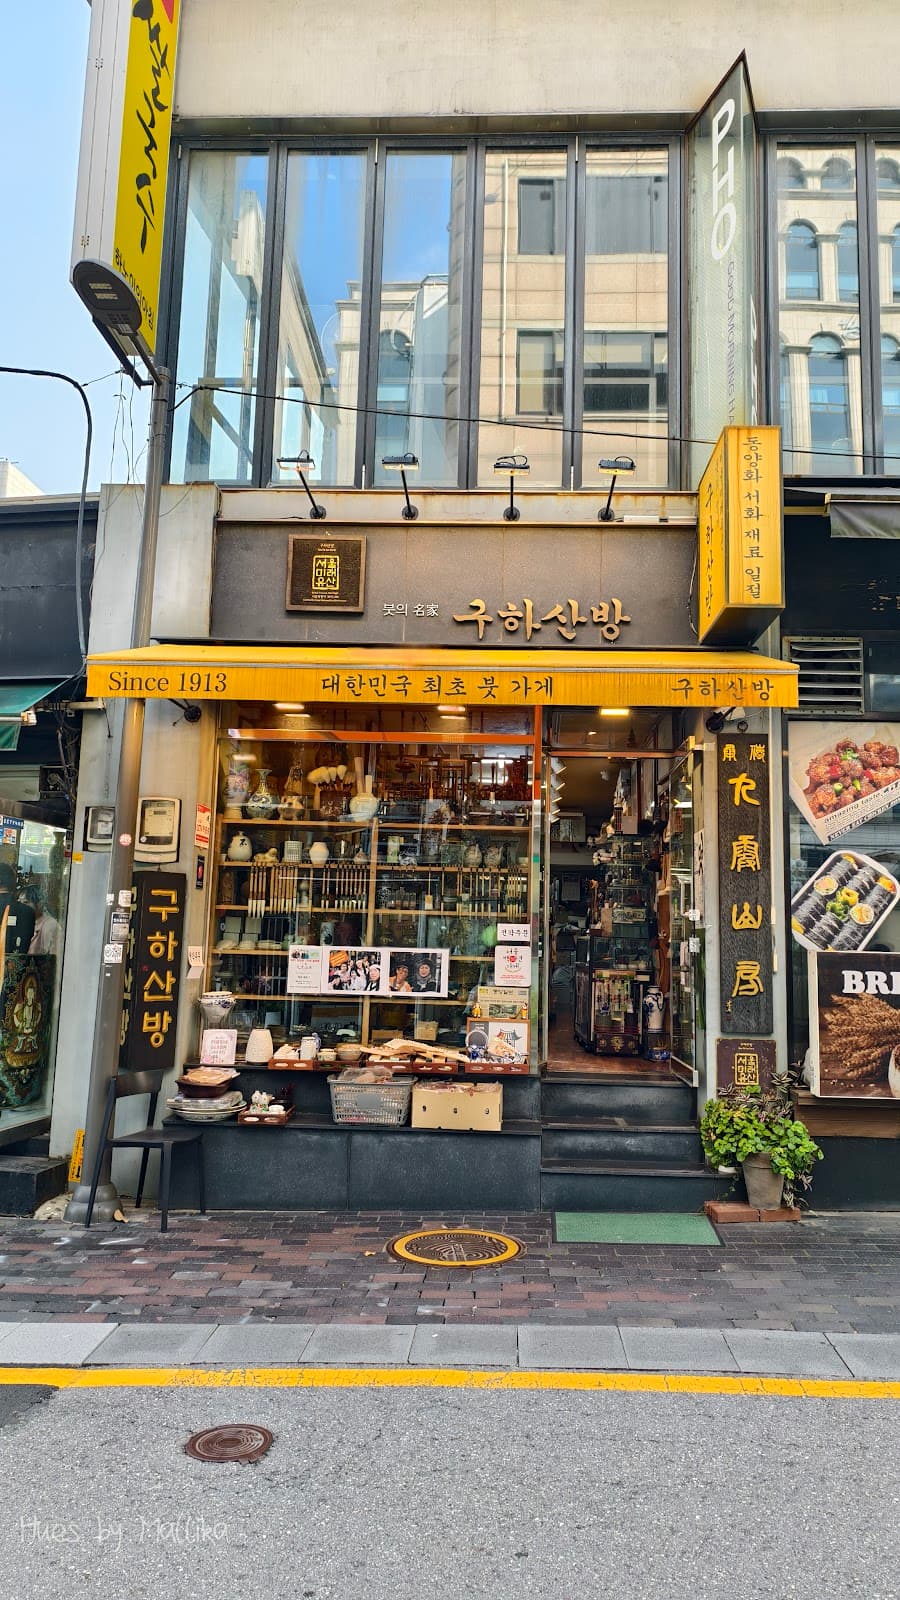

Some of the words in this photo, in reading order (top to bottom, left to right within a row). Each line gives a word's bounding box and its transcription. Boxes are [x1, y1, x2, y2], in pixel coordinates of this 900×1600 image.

[711, 98, 737, 261] PHO
[743, 436, 763, 484] 동양화
[744, 491, 763, 521] 서화
[743, 528, 764, 558] 재료
[315, 568, 337, 577] 미래
[316, 558, 337, 568] 서울
[315, 577, 337, 588] 유산
[382, 602, 409, 617] 붓의
[412, 602, 439, 617] 名家
[452, 598, 632, 642] 구하산방
[108, 671, 169, 692] Since
[177, 672, 227, 693] 1913
[321, 674, 411, 697] 대한민국
[422, 675, 467, 698] 최초
[477, 675, 499, 699] 붓
[511, 675, 553, 699] 가게
[671, 677, 774, 701] 구하산방
[143, 888, 179, 1049] 구하산방
